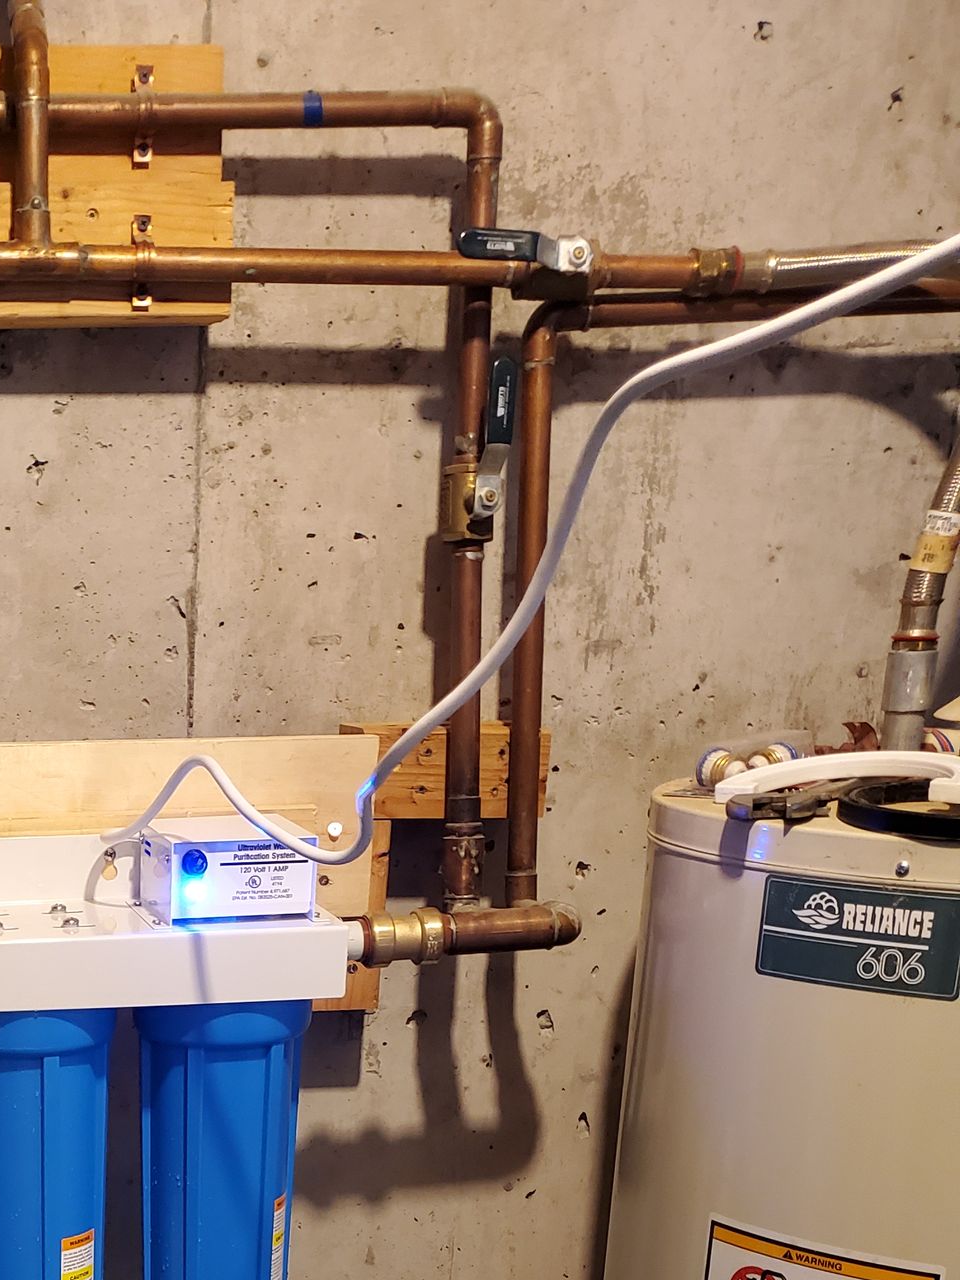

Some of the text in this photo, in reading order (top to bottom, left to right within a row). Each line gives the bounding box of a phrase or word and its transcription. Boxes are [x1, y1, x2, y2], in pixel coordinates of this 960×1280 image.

[842, 903, 935, 939] RELIANCE
[857, 947, 925, 985] 606
[70, 1235, 90, 1246] WARNING
[795, 1253, 842, 1272] WARNING
[70, 1271, 89, 1280] CAUTION
